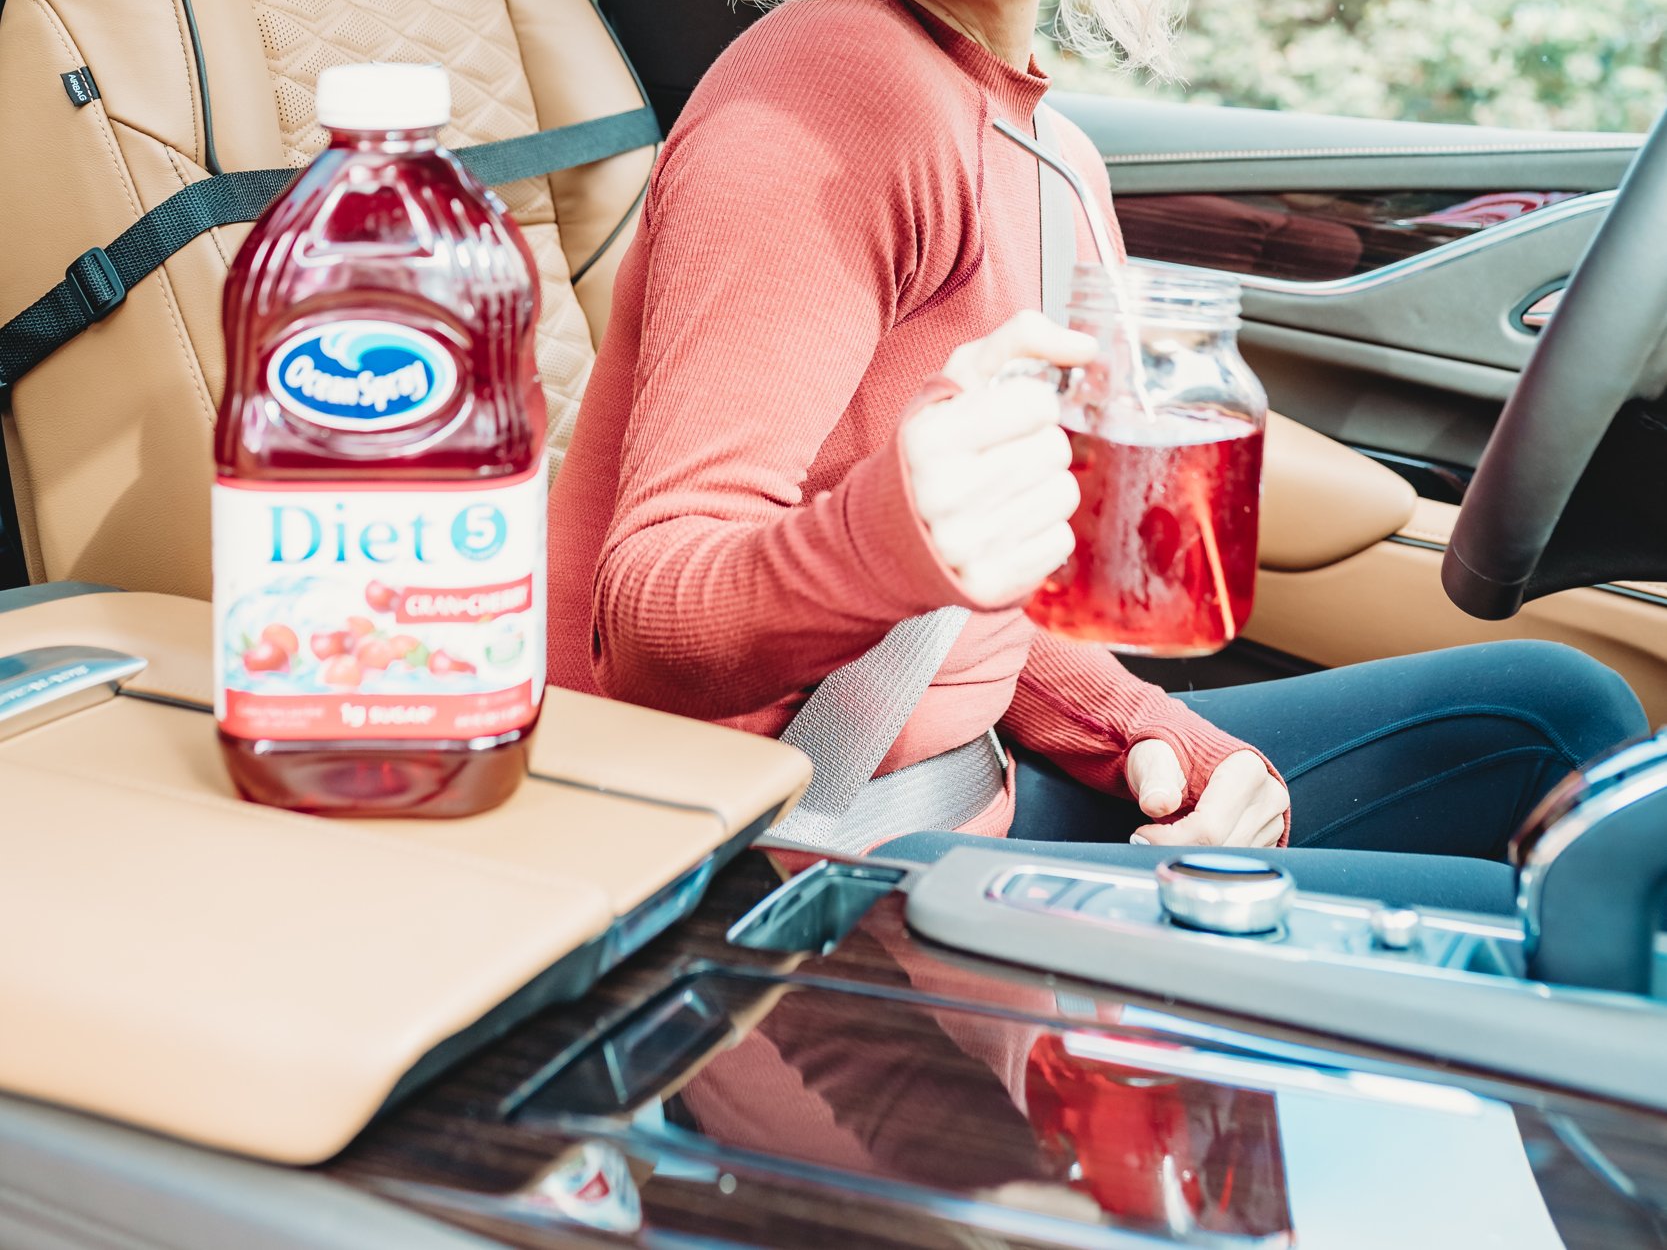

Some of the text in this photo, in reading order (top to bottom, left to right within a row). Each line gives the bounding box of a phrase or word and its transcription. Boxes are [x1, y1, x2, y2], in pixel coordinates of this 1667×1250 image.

[68, 75, 87, 101] AIRBAG
[268, 503, 497, 563] Diet 5
[340, 702, 366, 728] 1g
